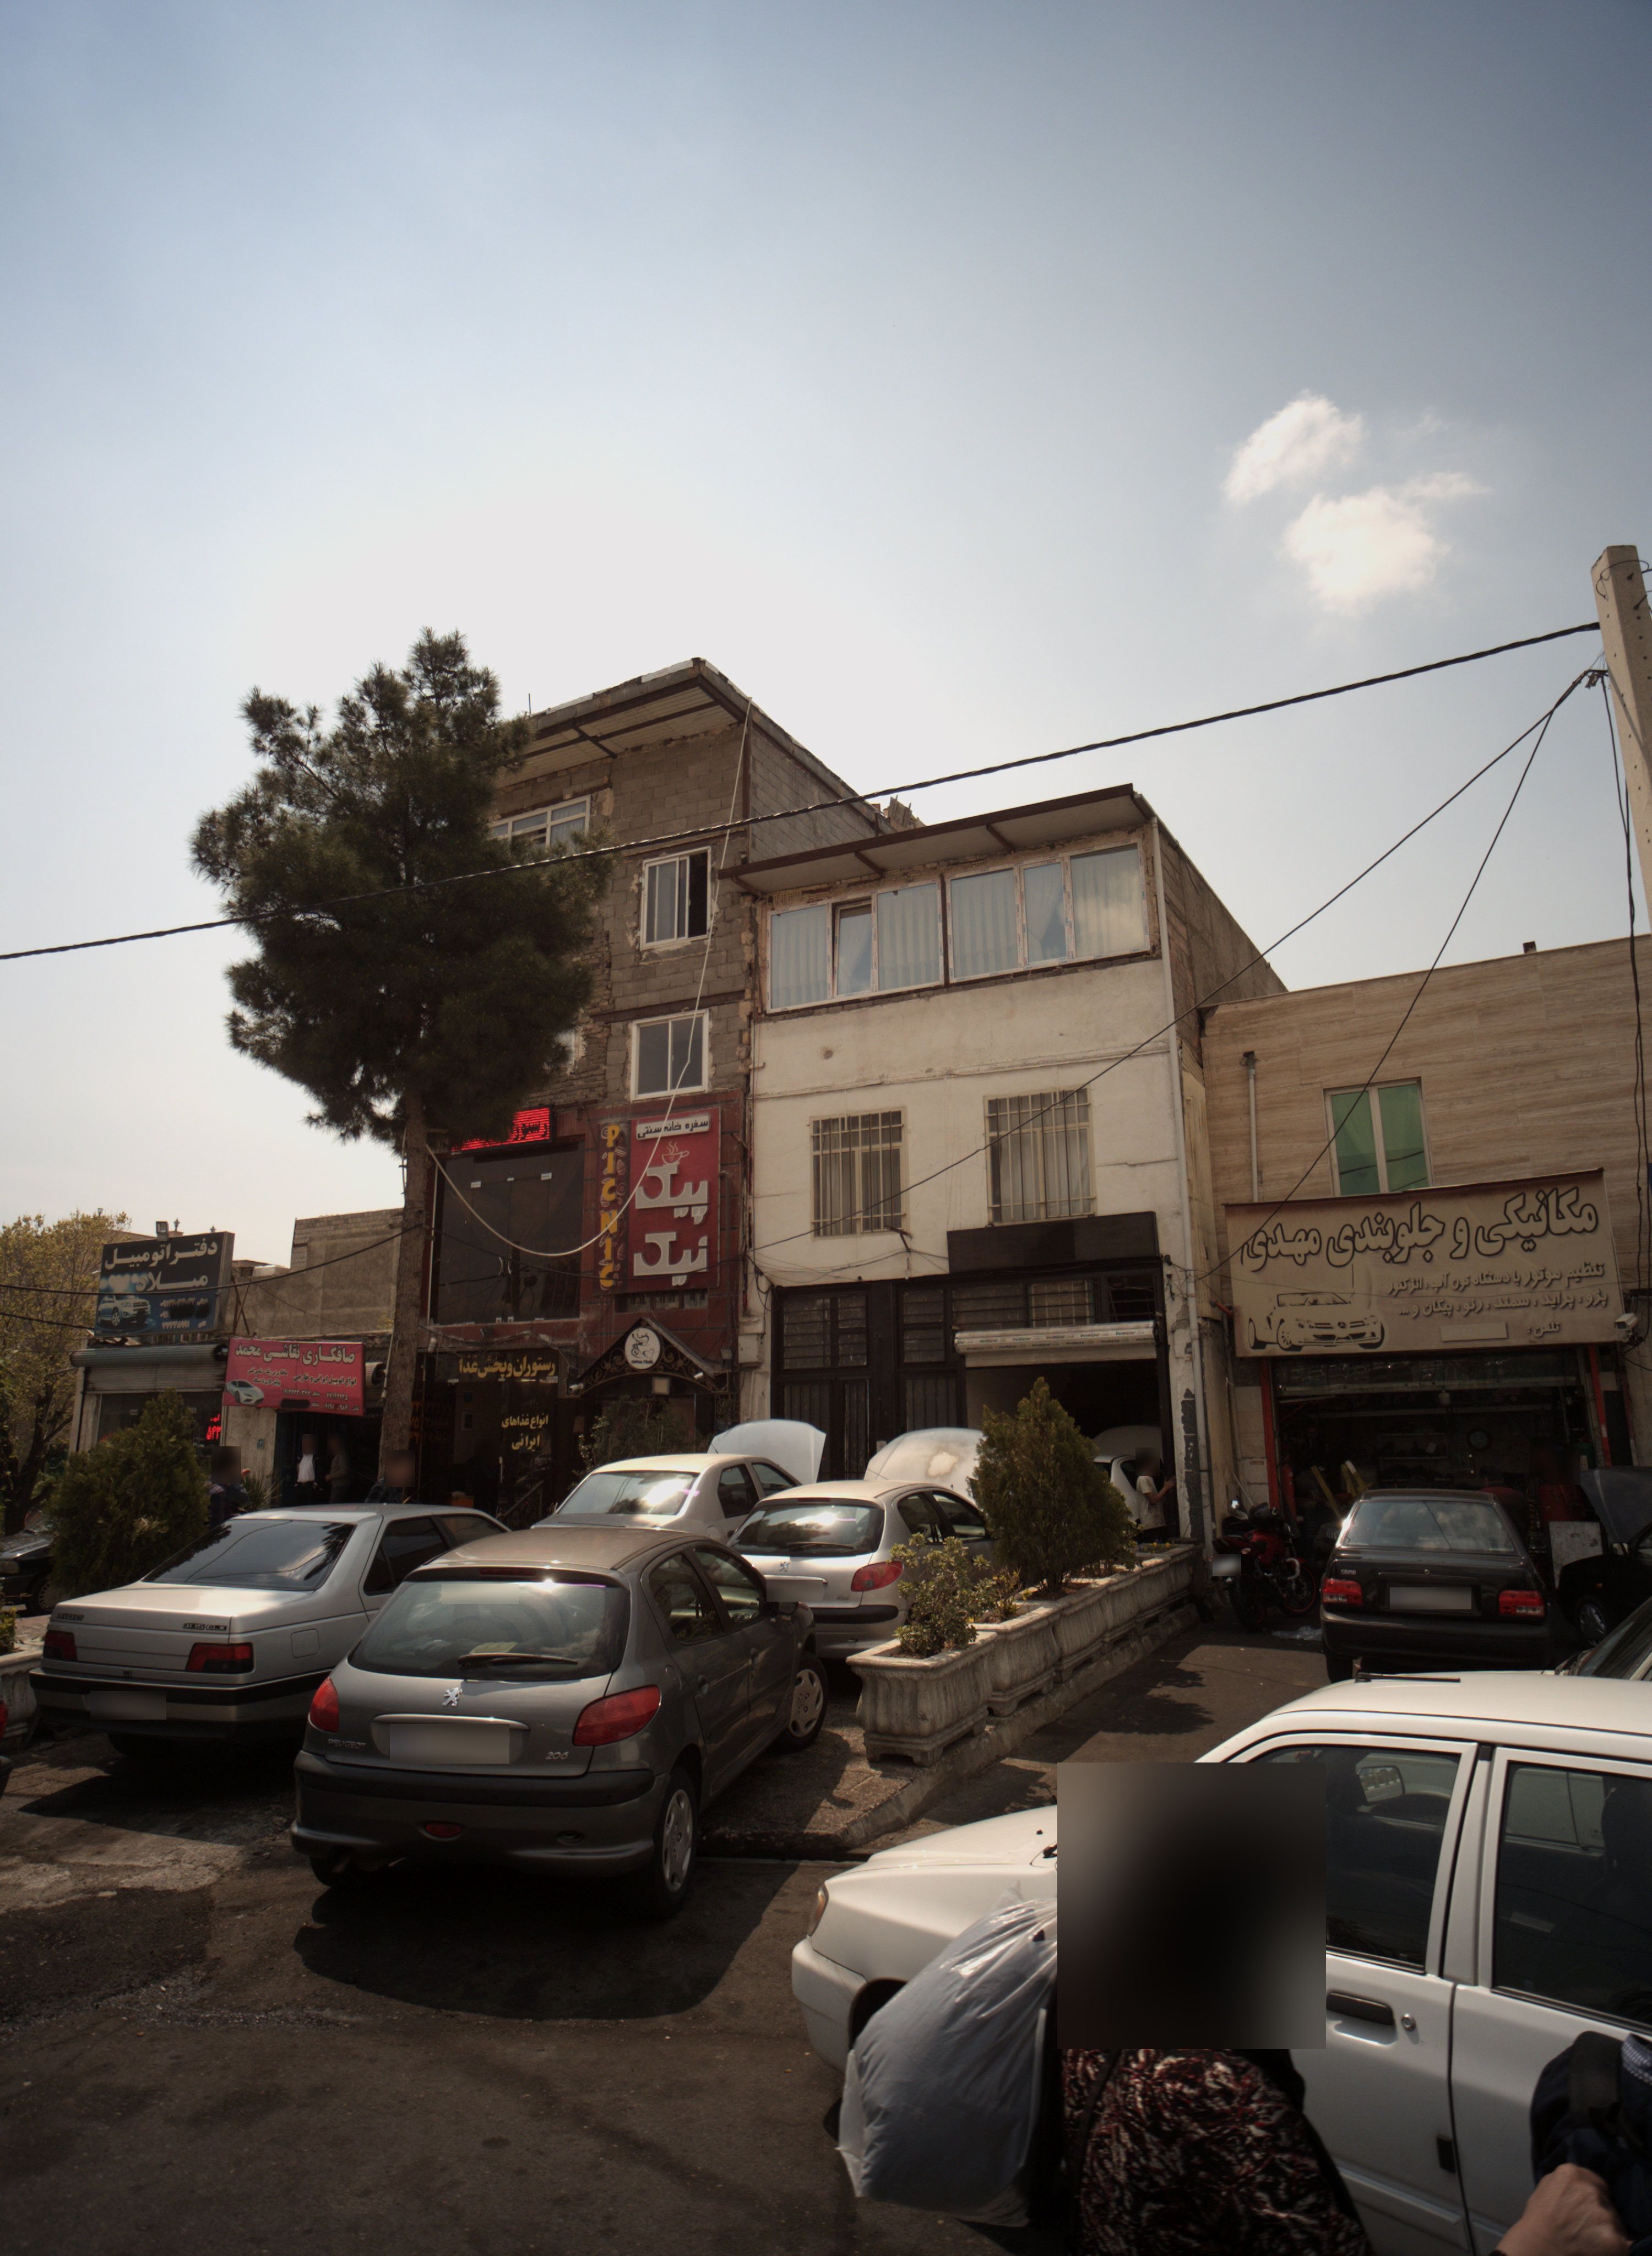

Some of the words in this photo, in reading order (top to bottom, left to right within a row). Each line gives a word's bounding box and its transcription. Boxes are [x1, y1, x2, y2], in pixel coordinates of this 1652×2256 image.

[638, 1126, 662, 1138] سنتی
[664, 1121, 682, 1132] خانه
[685, 1120, 708, 1132] سفره
[635, 1165, 708, 1225] پیک
[599, 1124, 620, 1288] PICNIC
[1475, 1186, 1599, 1256] مکانیکی
[1327, 1201, 1446, 1268] جلوبندی
[1450, 1217, 1470, 1260] و
[105, 1243, 172, 1270] اتومبیل
[169, 1237, 218, 1265] دفتر
[1241, 1223, 1322, 1273] مهدی
[634, 1232, 708, 1287] نیک
[1473, 1271, 1510, 1286] دستگاه
[1513, 1270, 1521, 1286] با
[1524, 1268, 1562, 1289] موتور
[1566, 1262, 1605, 1288] تنظیم
[1388, 1277, 1423, 1297] انژکتور
[1412, 1305, 1419, 1319] و
[1423, 1300, 1453, 1317] پیکان
[235, 1343, 262, 1357] محمد
[263, 1343, 301, 1363] نقاشی
[302, 1344, 356, 1366] صافکاری
[459, 1354, 478, 1374] غذا
[477, 1355, 507, 1379] پخش
[505, 1364, 513, 1378] و
[513, 1354, 556, 1378] رستوران
[292, 1374, 309, 1382] خارجی
[314, 1374, 328, 1384] ایرانی
[328, 1376, 345, 1386] اتومبیل
[345, 1378, 357, 1387] انواع
[501, 1414, 530, 1429] غذاهای
[529, 1412, 549, 1430] انواع
[511, 1433, 541, 1452] ایرانی
[328, 1738, 367, 1749] PEUGEOT
[545, 1751, 569, 1760] 206
